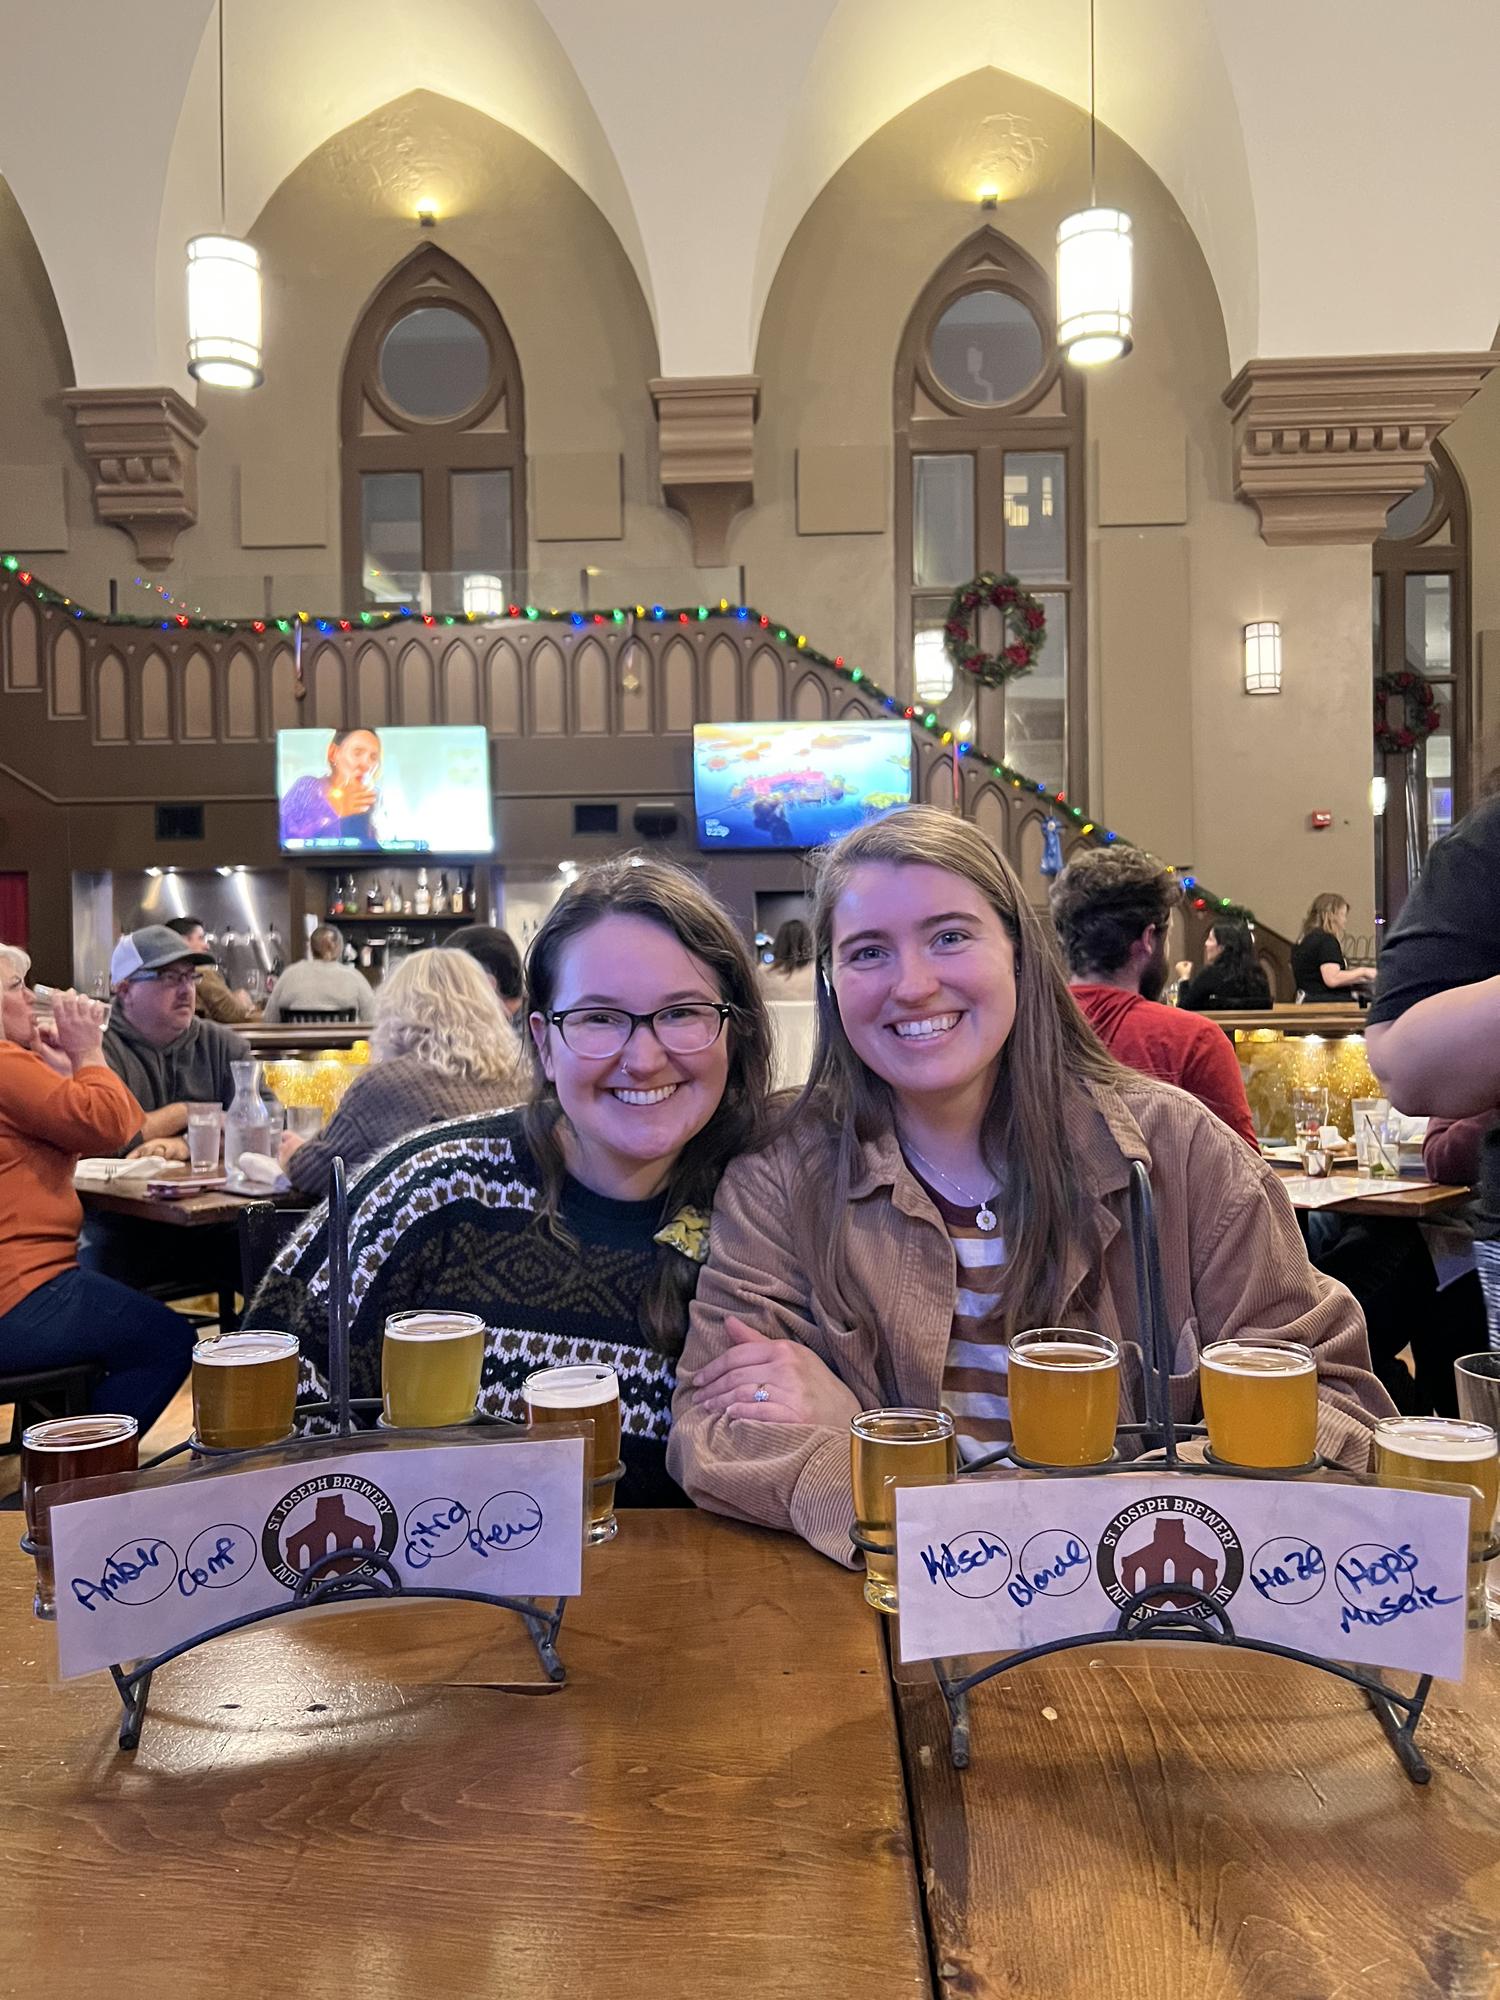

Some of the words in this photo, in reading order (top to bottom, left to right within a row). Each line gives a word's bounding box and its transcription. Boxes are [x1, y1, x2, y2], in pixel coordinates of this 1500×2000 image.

[267, 1515, 281, 1531] ST
[277, 1477, 328, 1515] JOSEPH
[332, 1476, 393, 1515] BREWERY
[1103, 1530, 1118, 1547] ST
[1113, 1498, 1169, 1531] JOSEPH
[1173, 1498, 1239, 1549] BREWERY
[71, 1540, 167, 1611] Amber
[1007, 1539, 1090, 1607] Blonde
[1213, 1585, 1233, 1605] IN
